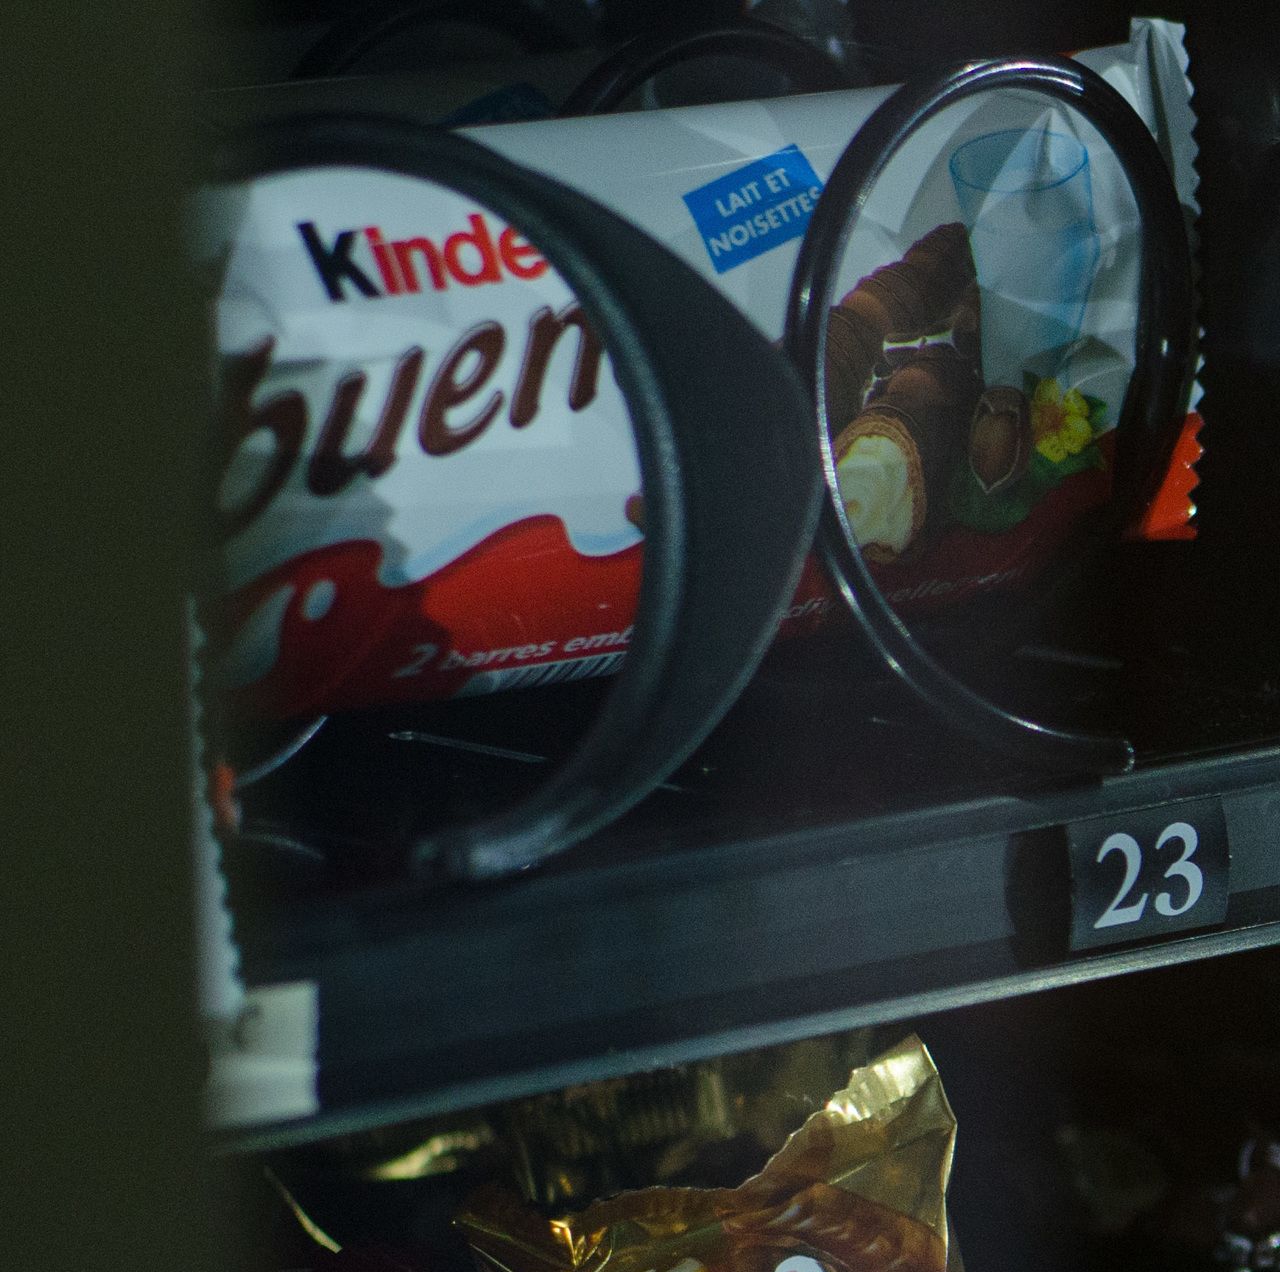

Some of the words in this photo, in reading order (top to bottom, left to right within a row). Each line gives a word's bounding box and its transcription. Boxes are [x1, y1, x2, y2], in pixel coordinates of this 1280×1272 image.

[715, 181, 762, 218] LAIT
[763, 168, 791, 193] ET
[297, 213, 553, 301] Kinde
[214, 301, 605, 536] buen
[394, 643, 438, 678] 2
[440, 640, 557, 671] barres
[1094, 821, 1204, 929] 23
